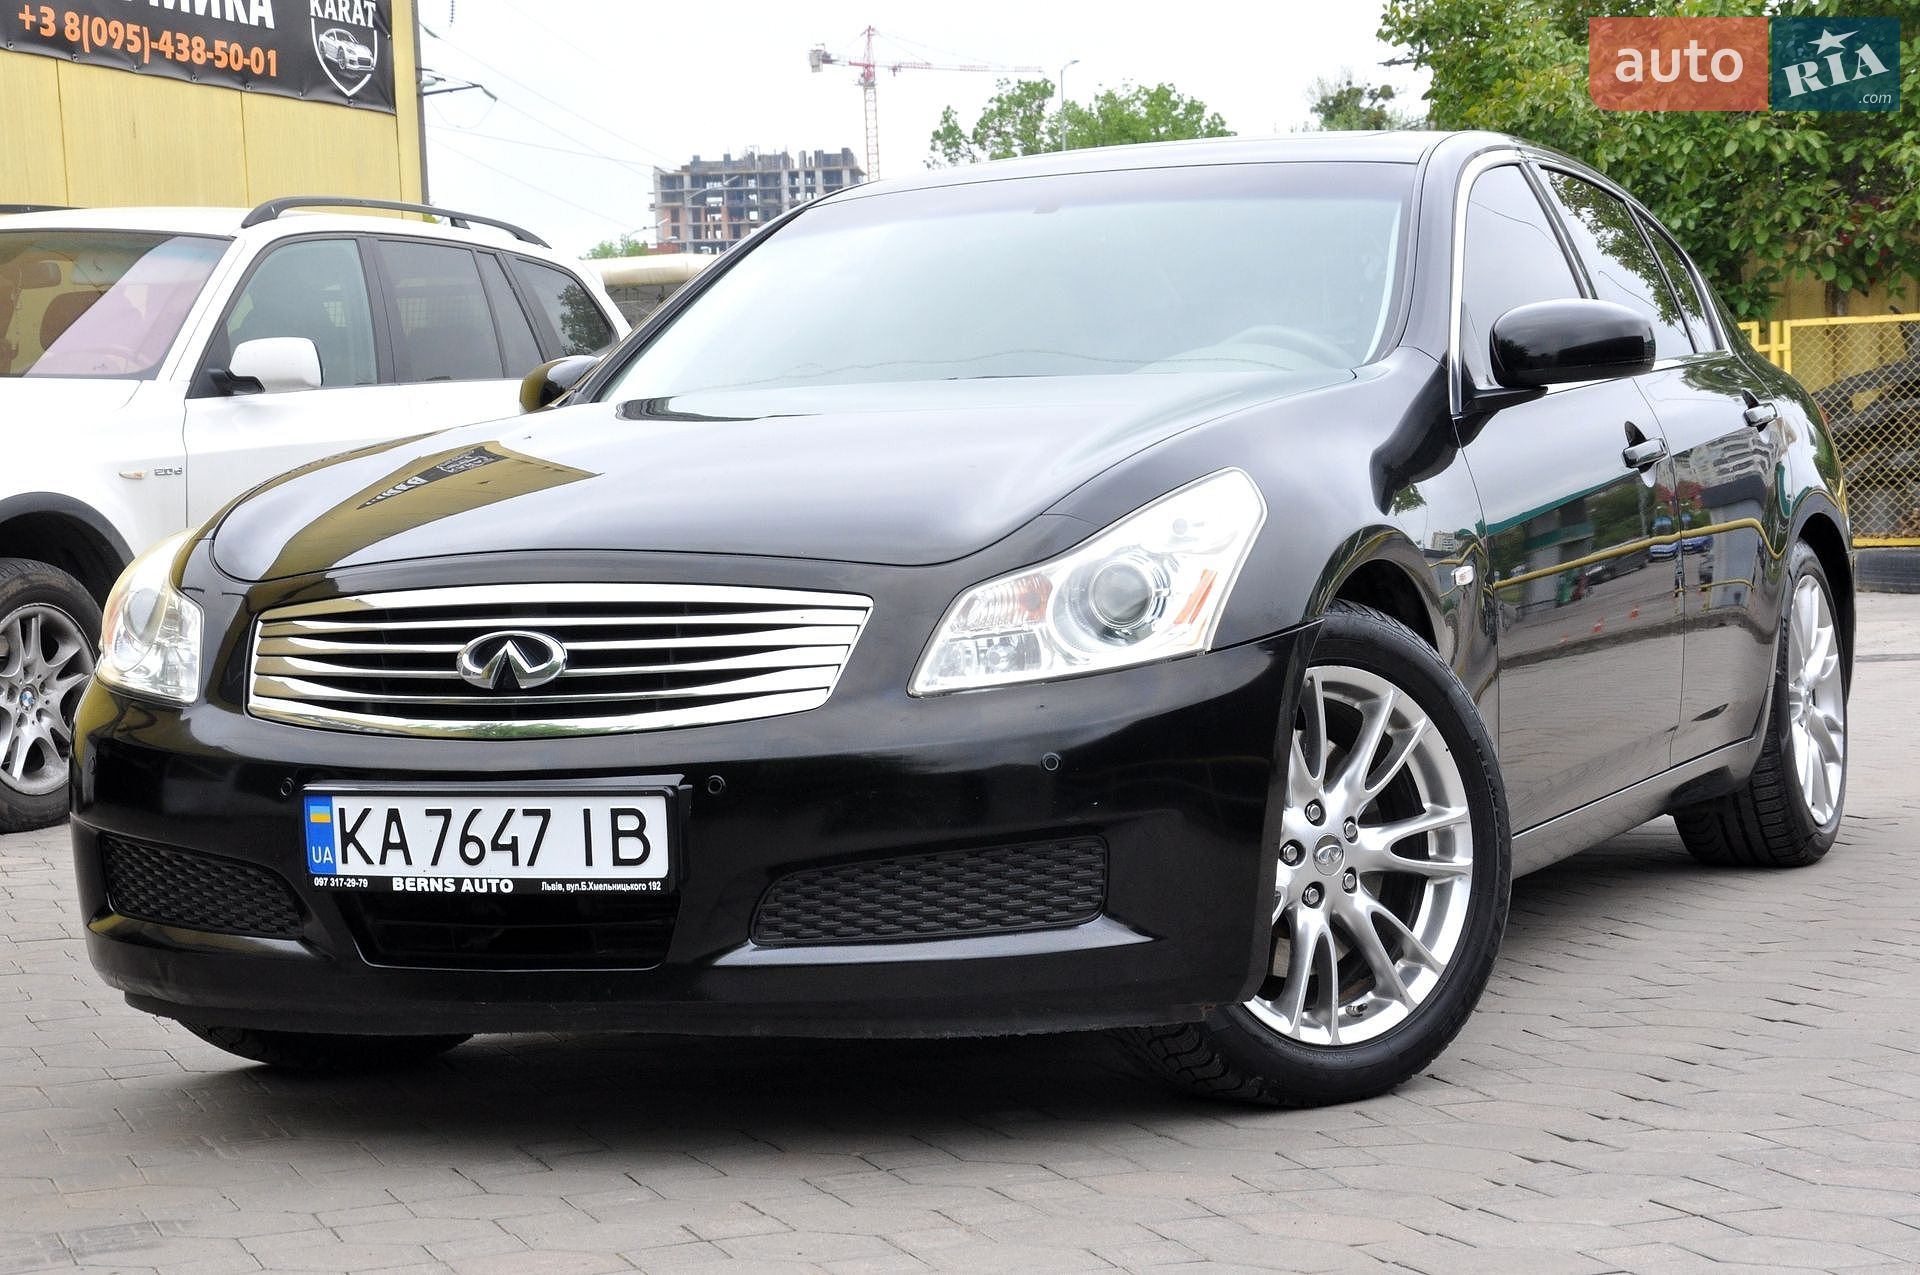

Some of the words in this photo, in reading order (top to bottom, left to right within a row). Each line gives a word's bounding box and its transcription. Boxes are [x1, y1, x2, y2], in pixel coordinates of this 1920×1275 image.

[310, 0, 377, 28] KARAT
[338, 807, 413, 866] KA
[424, 808, 551, 867] 7647
[583, 808, 651, 867] IB
[311, 846, 334, 864] UA
[314, 877, 328, 887] 097
[329, 878, 369, 888] 317-29-79
[392, 877, 456, 892] BERNS
[460, 878, 514, 893] AUTO
[541, 881, 565, 892] Львів,
[648, 881, 661, 891] 192
